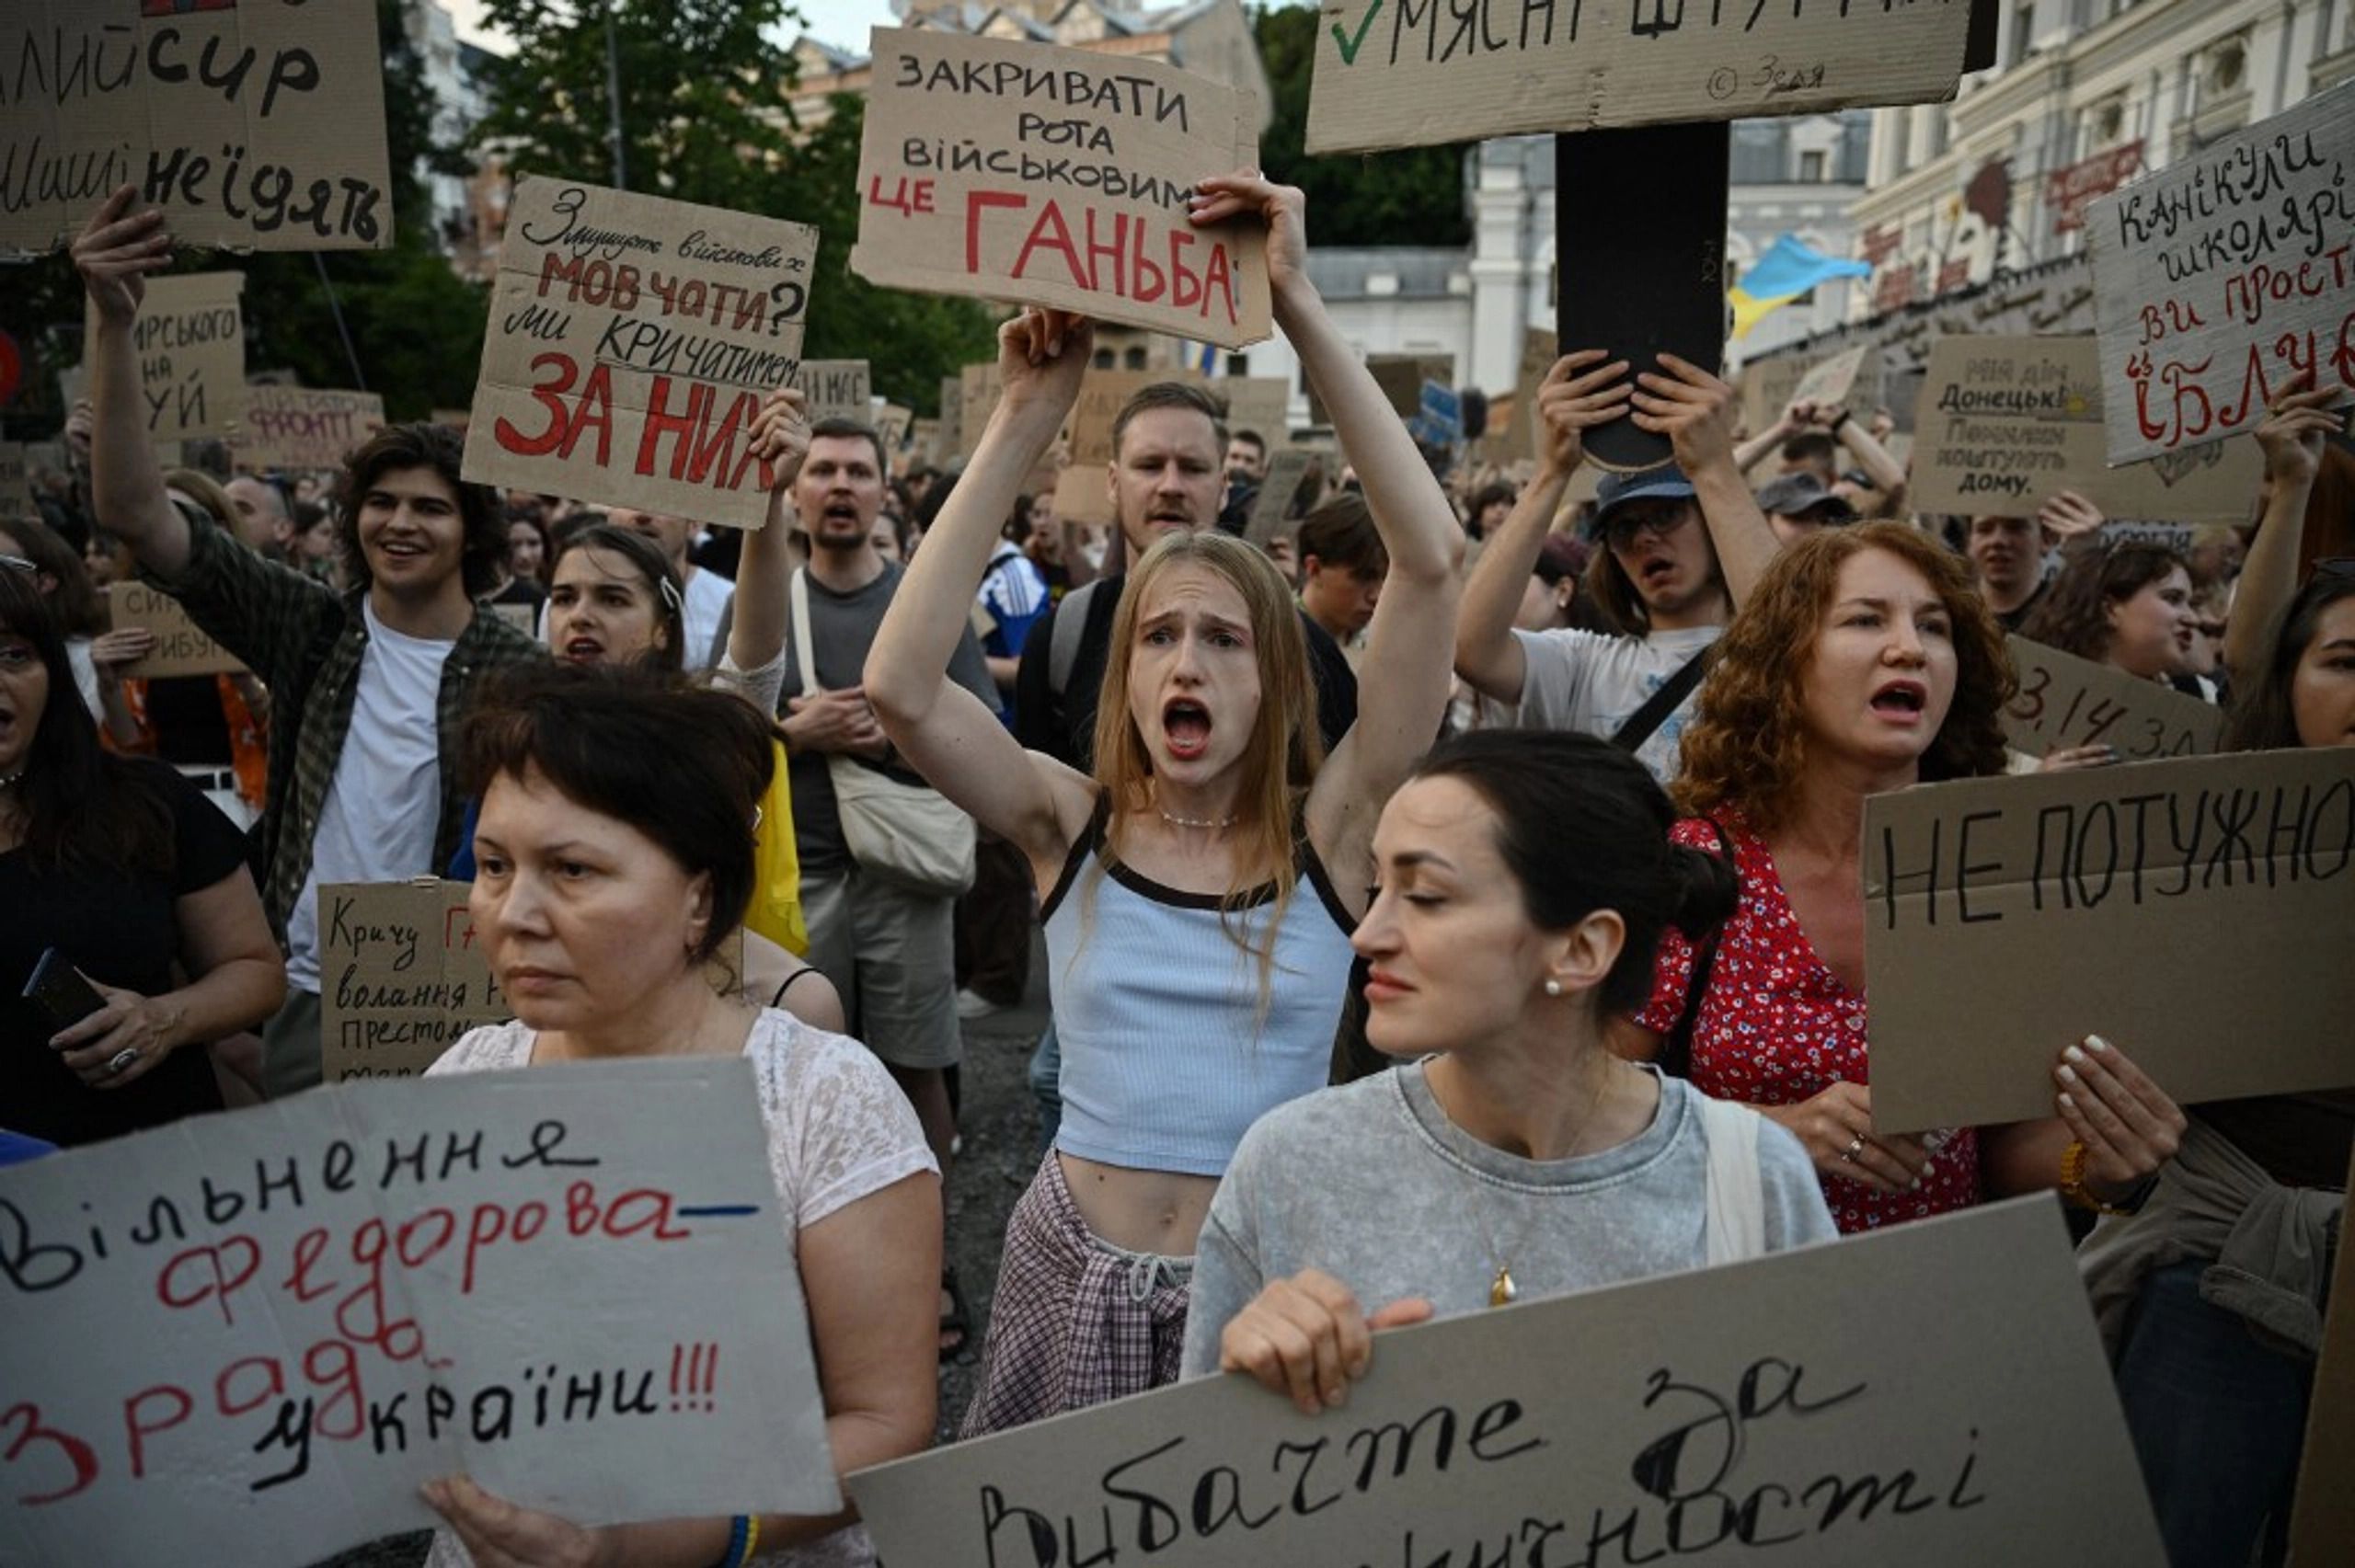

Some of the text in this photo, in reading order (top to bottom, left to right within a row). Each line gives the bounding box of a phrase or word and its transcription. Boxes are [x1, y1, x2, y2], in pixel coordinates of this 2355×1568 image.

[895, 54, 1189, 132] ЗАКРИВАТИ
[1017, 111, 1115, 155] РОТА
[869, 175, 1237, 326] ЦЕ ГАНЬБА
[2225, 241, 2355, 326] ПРОСТ
[144, 370, 206, 430] УЙ
[494, 351, 615, 469] ЗА
[1937, 383, 2066, 412] Донецьк!
[1883, 778, 2355, 931] НЕ ПОТУЖНО
[328, 896, 419, 971] Кричу
